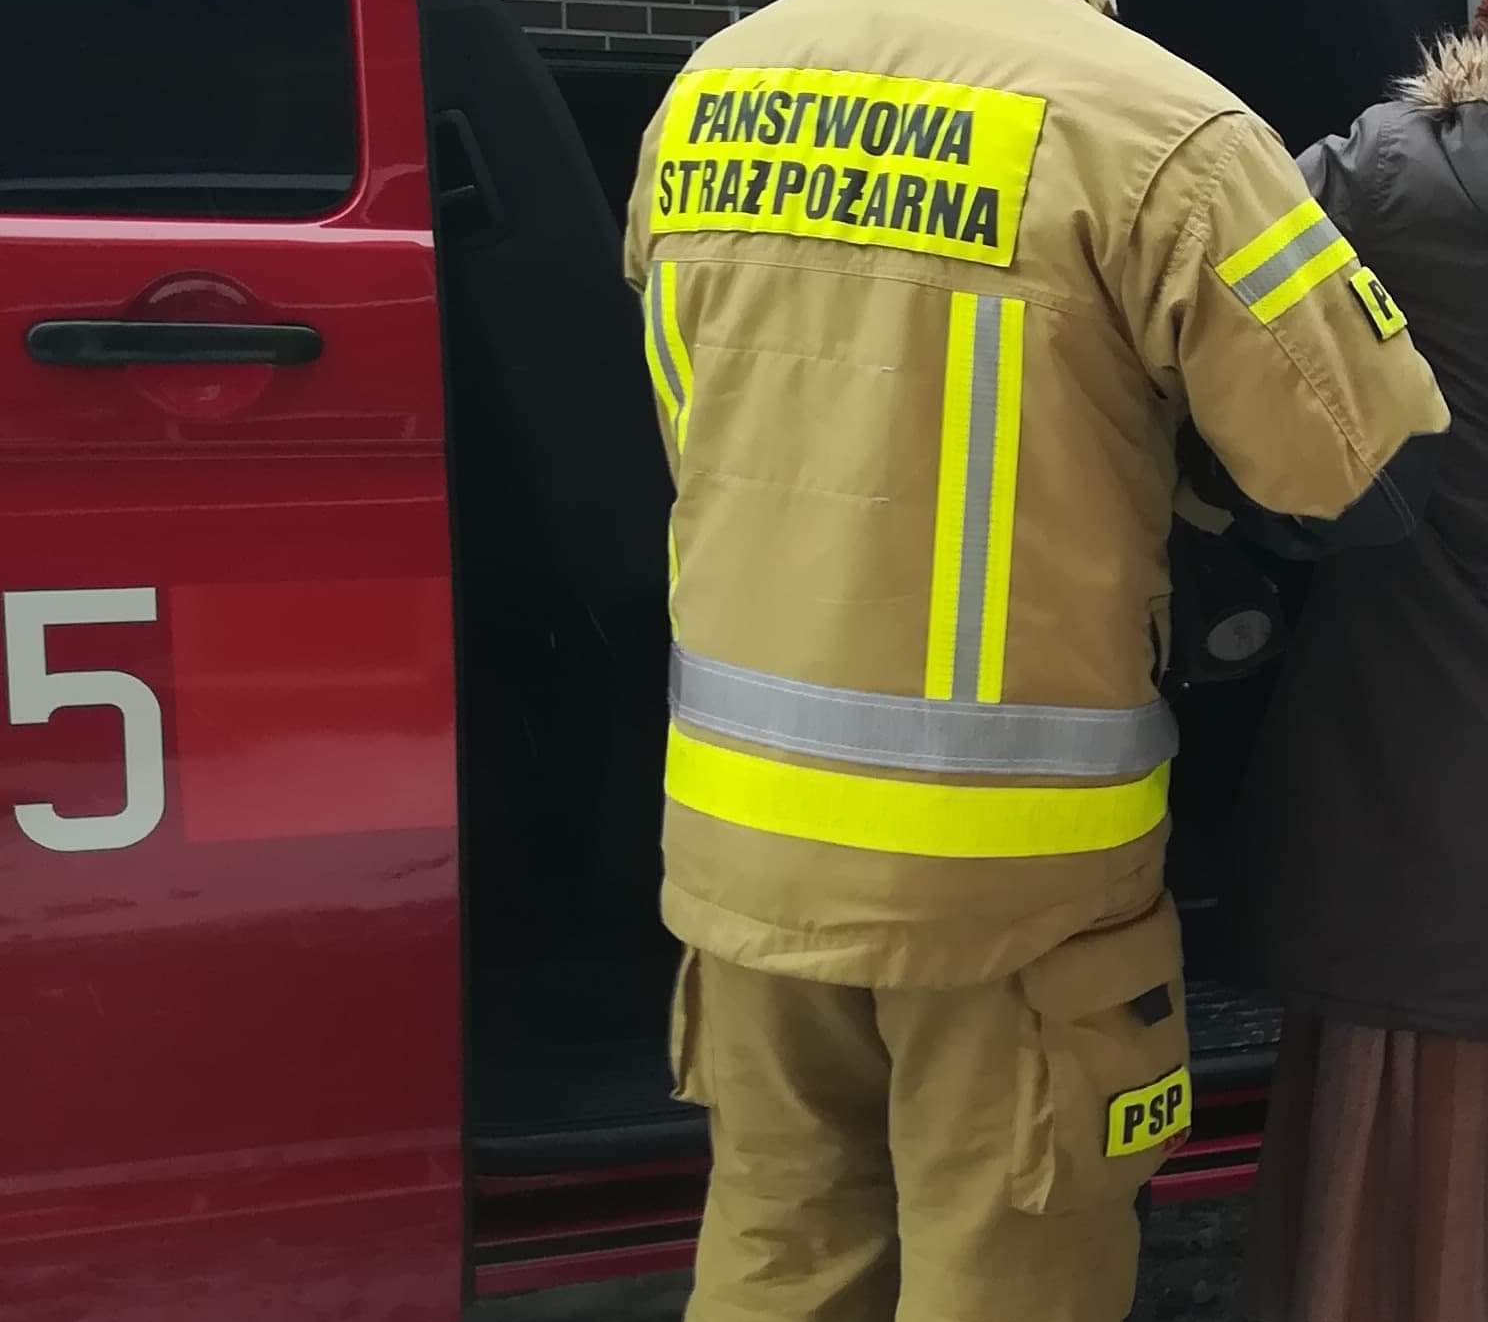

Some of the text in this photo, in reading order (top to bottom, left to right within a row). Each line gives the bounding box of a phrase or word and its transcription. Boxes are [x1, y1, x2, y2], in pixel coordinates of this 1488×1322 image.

[688, 81, 976, 166] PAŃSTWOWA
[3, 587, 166, 853] 5
[1122, 1084, 1183, 1145] PSP
